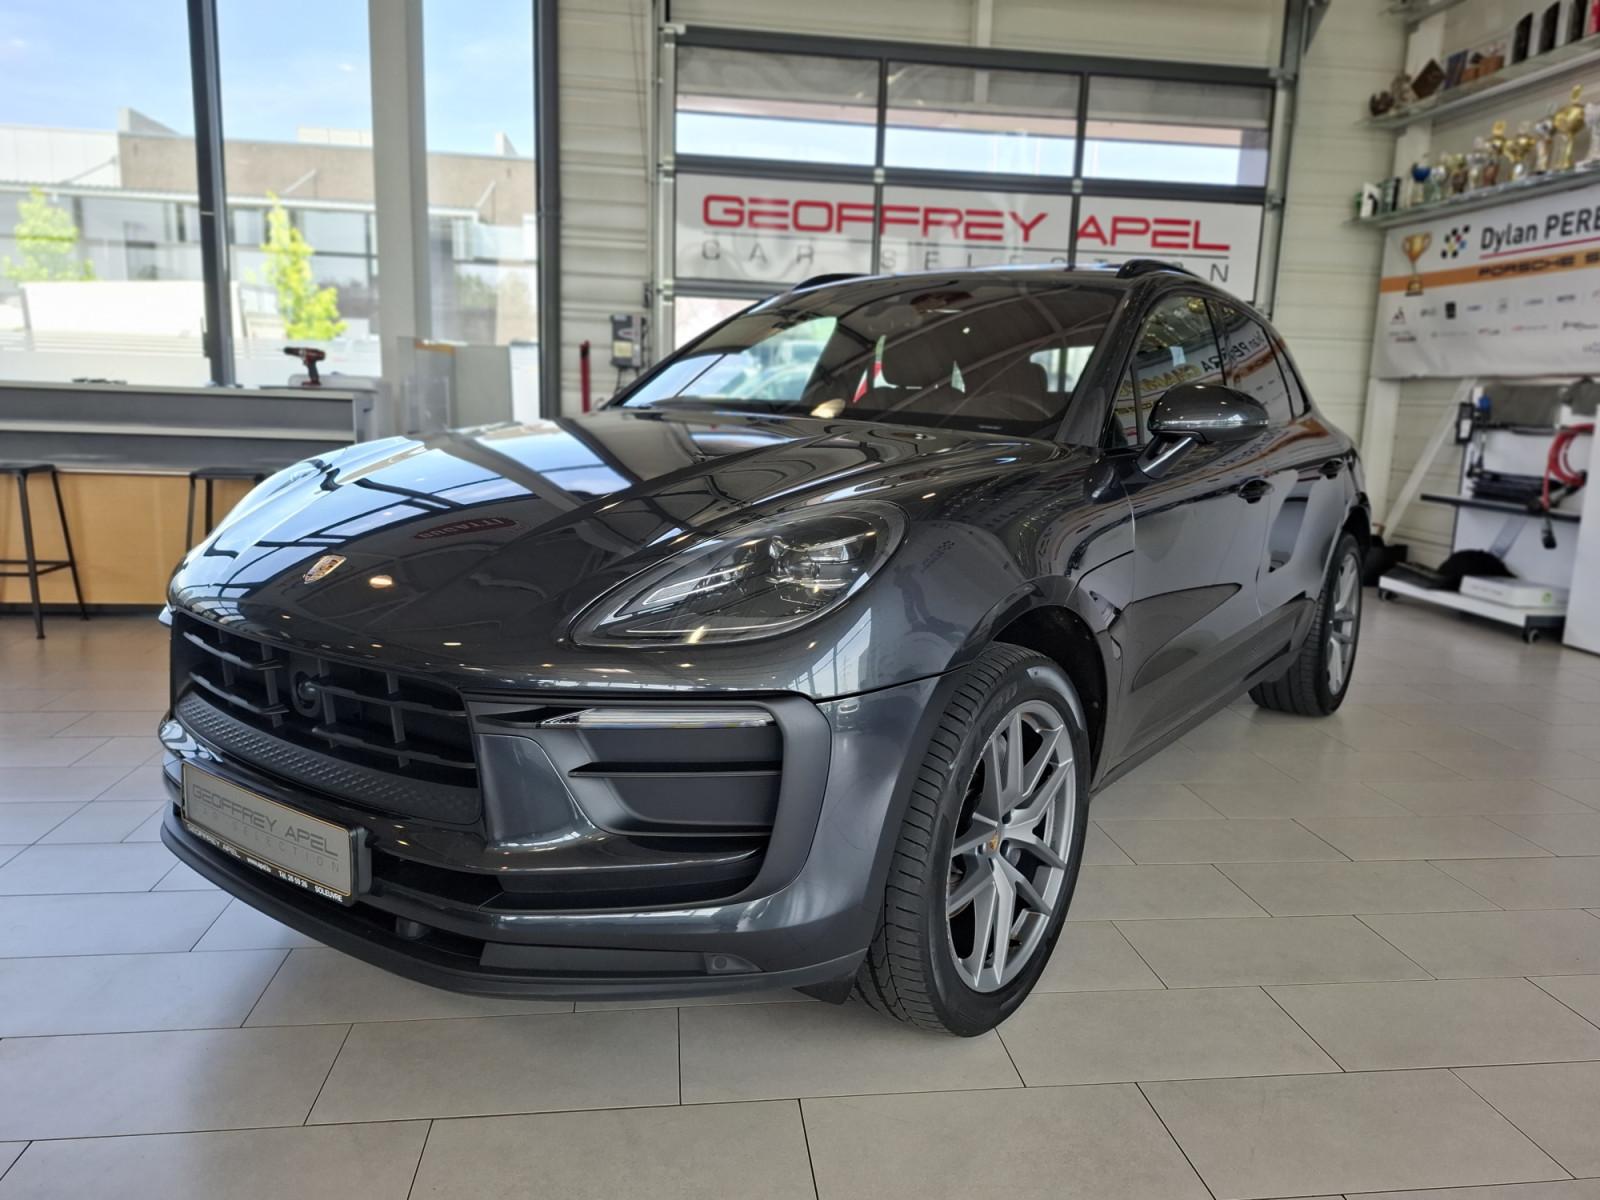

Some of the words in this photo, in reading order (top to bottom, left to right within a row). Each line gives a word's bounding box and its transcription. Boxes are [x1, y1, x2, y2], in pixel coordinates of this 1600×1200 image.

[702, 193, 1048, 243] GEOFFREY
[1075, 214, 1231, 252] APEL
[1480, 222, 1538, 252] Dylan
[701, 239, 814, 264] CAR
[1478, 254, 1575, 276] PORSCHE
[192, 783, 278, 832] GEOFFREY
[284, 825, 339, 857] APEL
